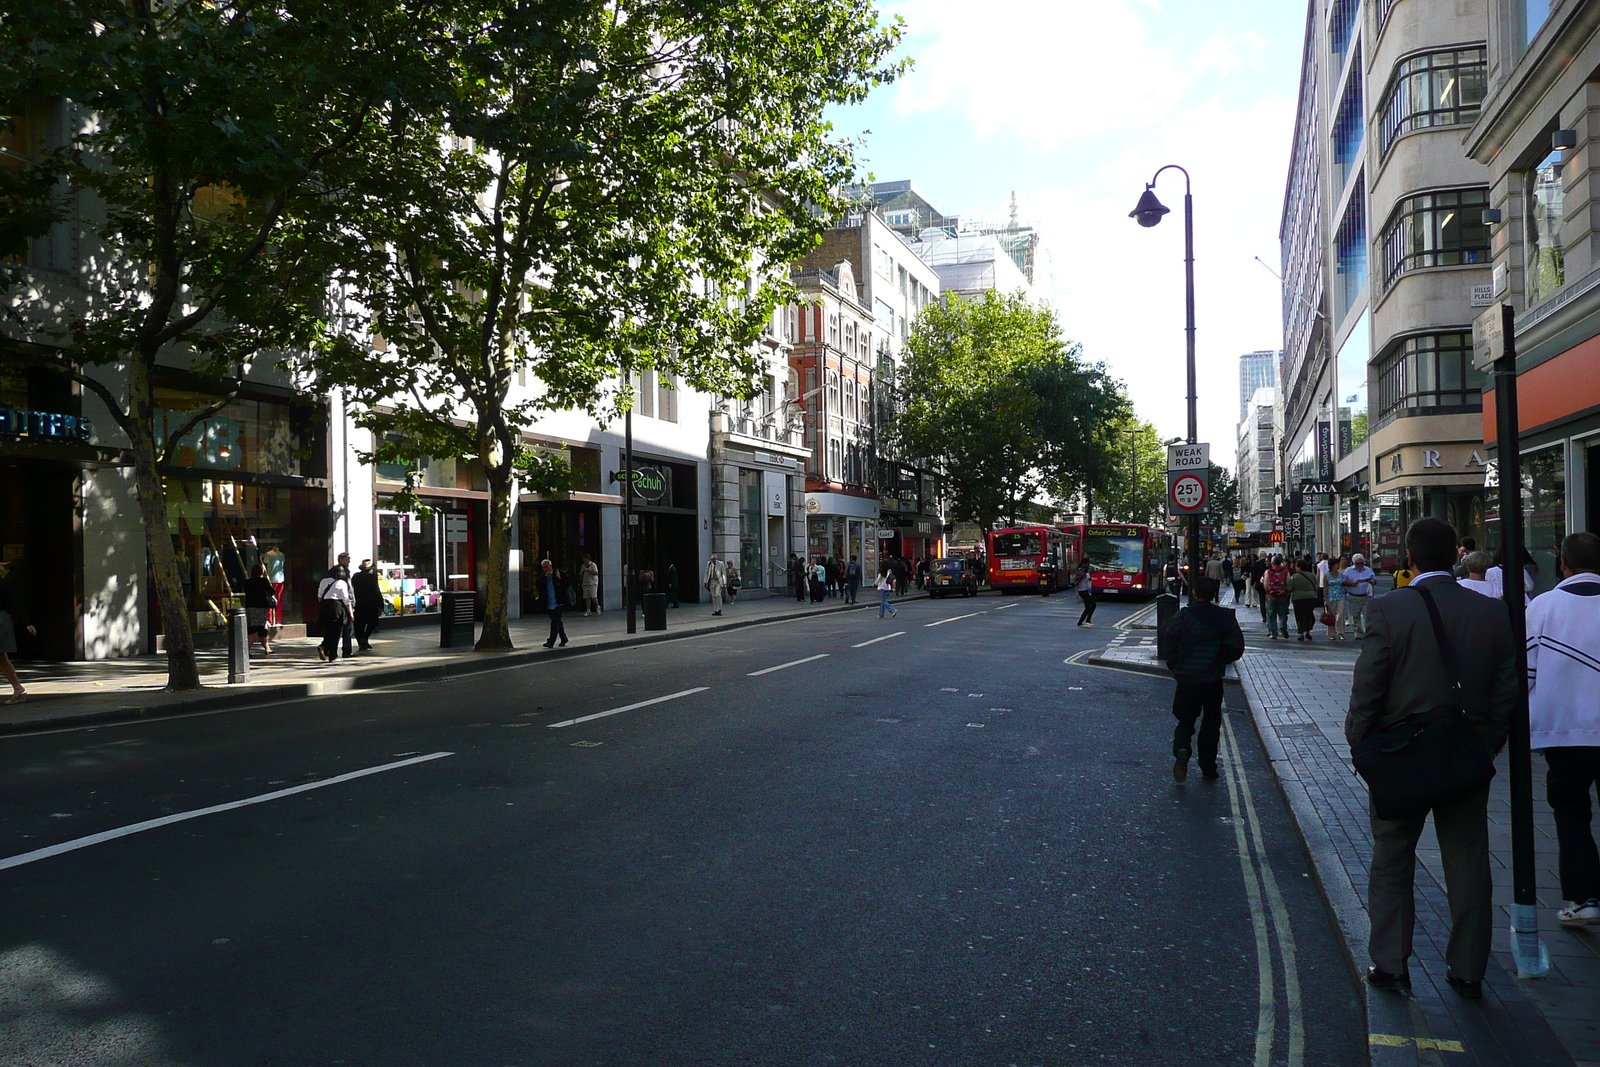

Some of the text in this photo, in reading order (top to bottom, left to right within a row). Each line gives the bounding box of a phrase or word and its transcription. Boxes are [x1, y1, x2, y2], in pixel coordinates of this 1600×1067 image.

[1175, 448, 1202, 457] WEAK
[1321, 427, 1329, 476] Superdrug
[1176, 457, 1202, 466] ROAD
[638, 474, 662, 491] schuh
[1302, 484, 1337, 493] ZARA
[1292, 513, 1301, 539] next
[1127, 528, 1137, 536] 25
